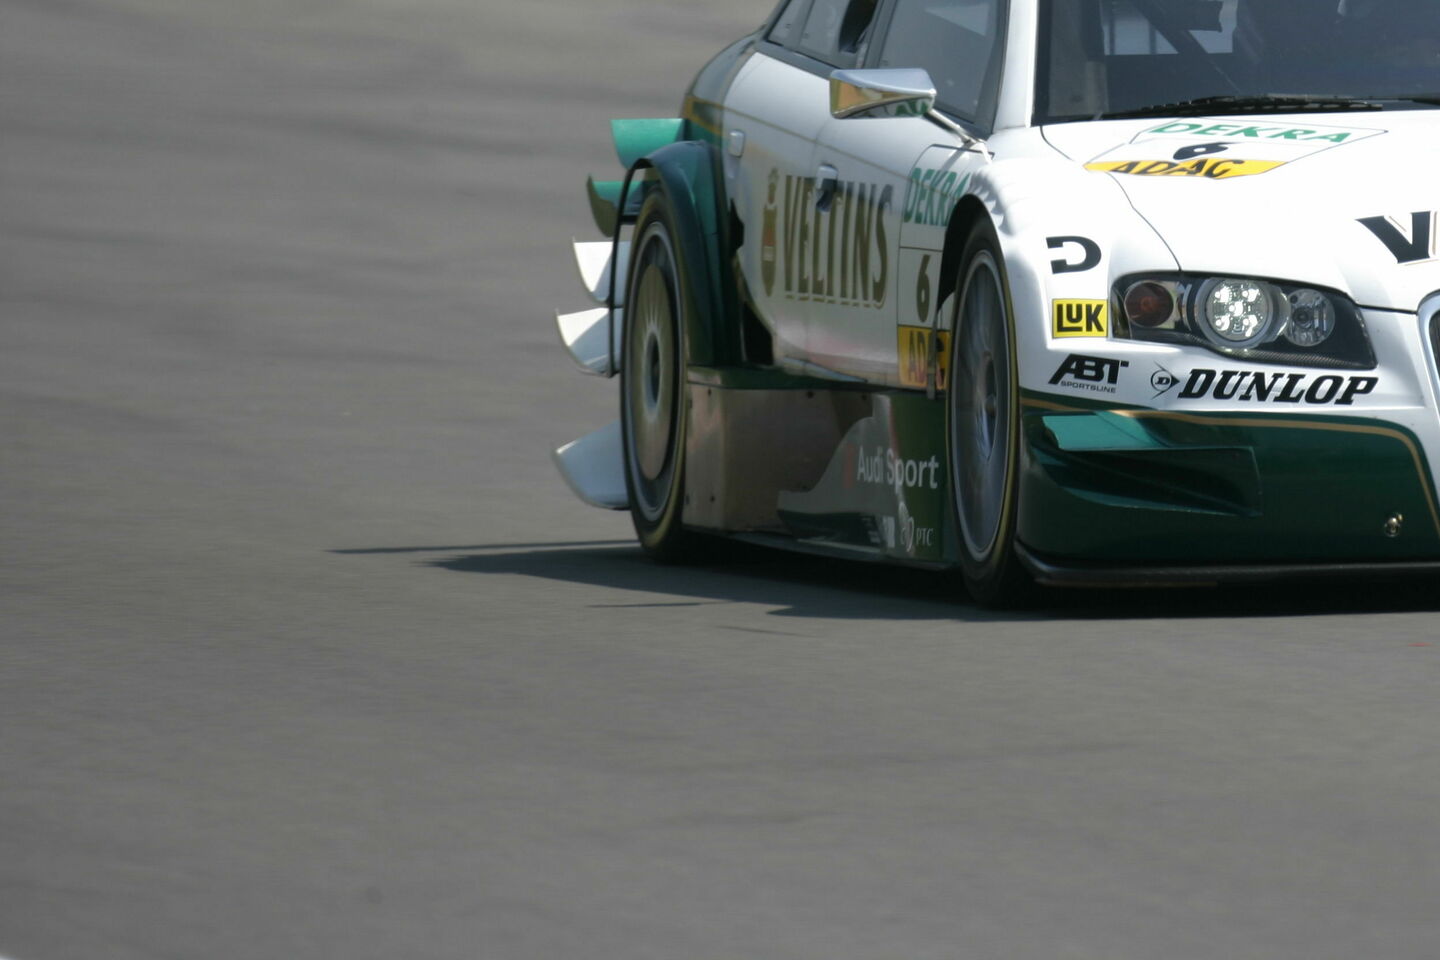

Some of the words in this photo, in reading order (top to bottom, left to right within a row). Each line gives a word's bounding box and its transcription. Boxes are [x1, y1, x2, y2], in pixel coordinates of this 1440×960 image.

[1149, 122, 1352, 143] DEKRA
[1173, 142, 1236, 161] 6
[1109, 159, 1245, 179] ADAC
[784, 174, 894, 309] VELTINS
[916, 253, 931, 323] 6
[1048, 353, 1130, 385] ABT
[1060, 380, 1117, 394] SPORTSLINE
[1178, 368, 1379, 405] DUNLOP
[857, 445, 884, 484] Audi
[886, 447, 940, 495] Sport
